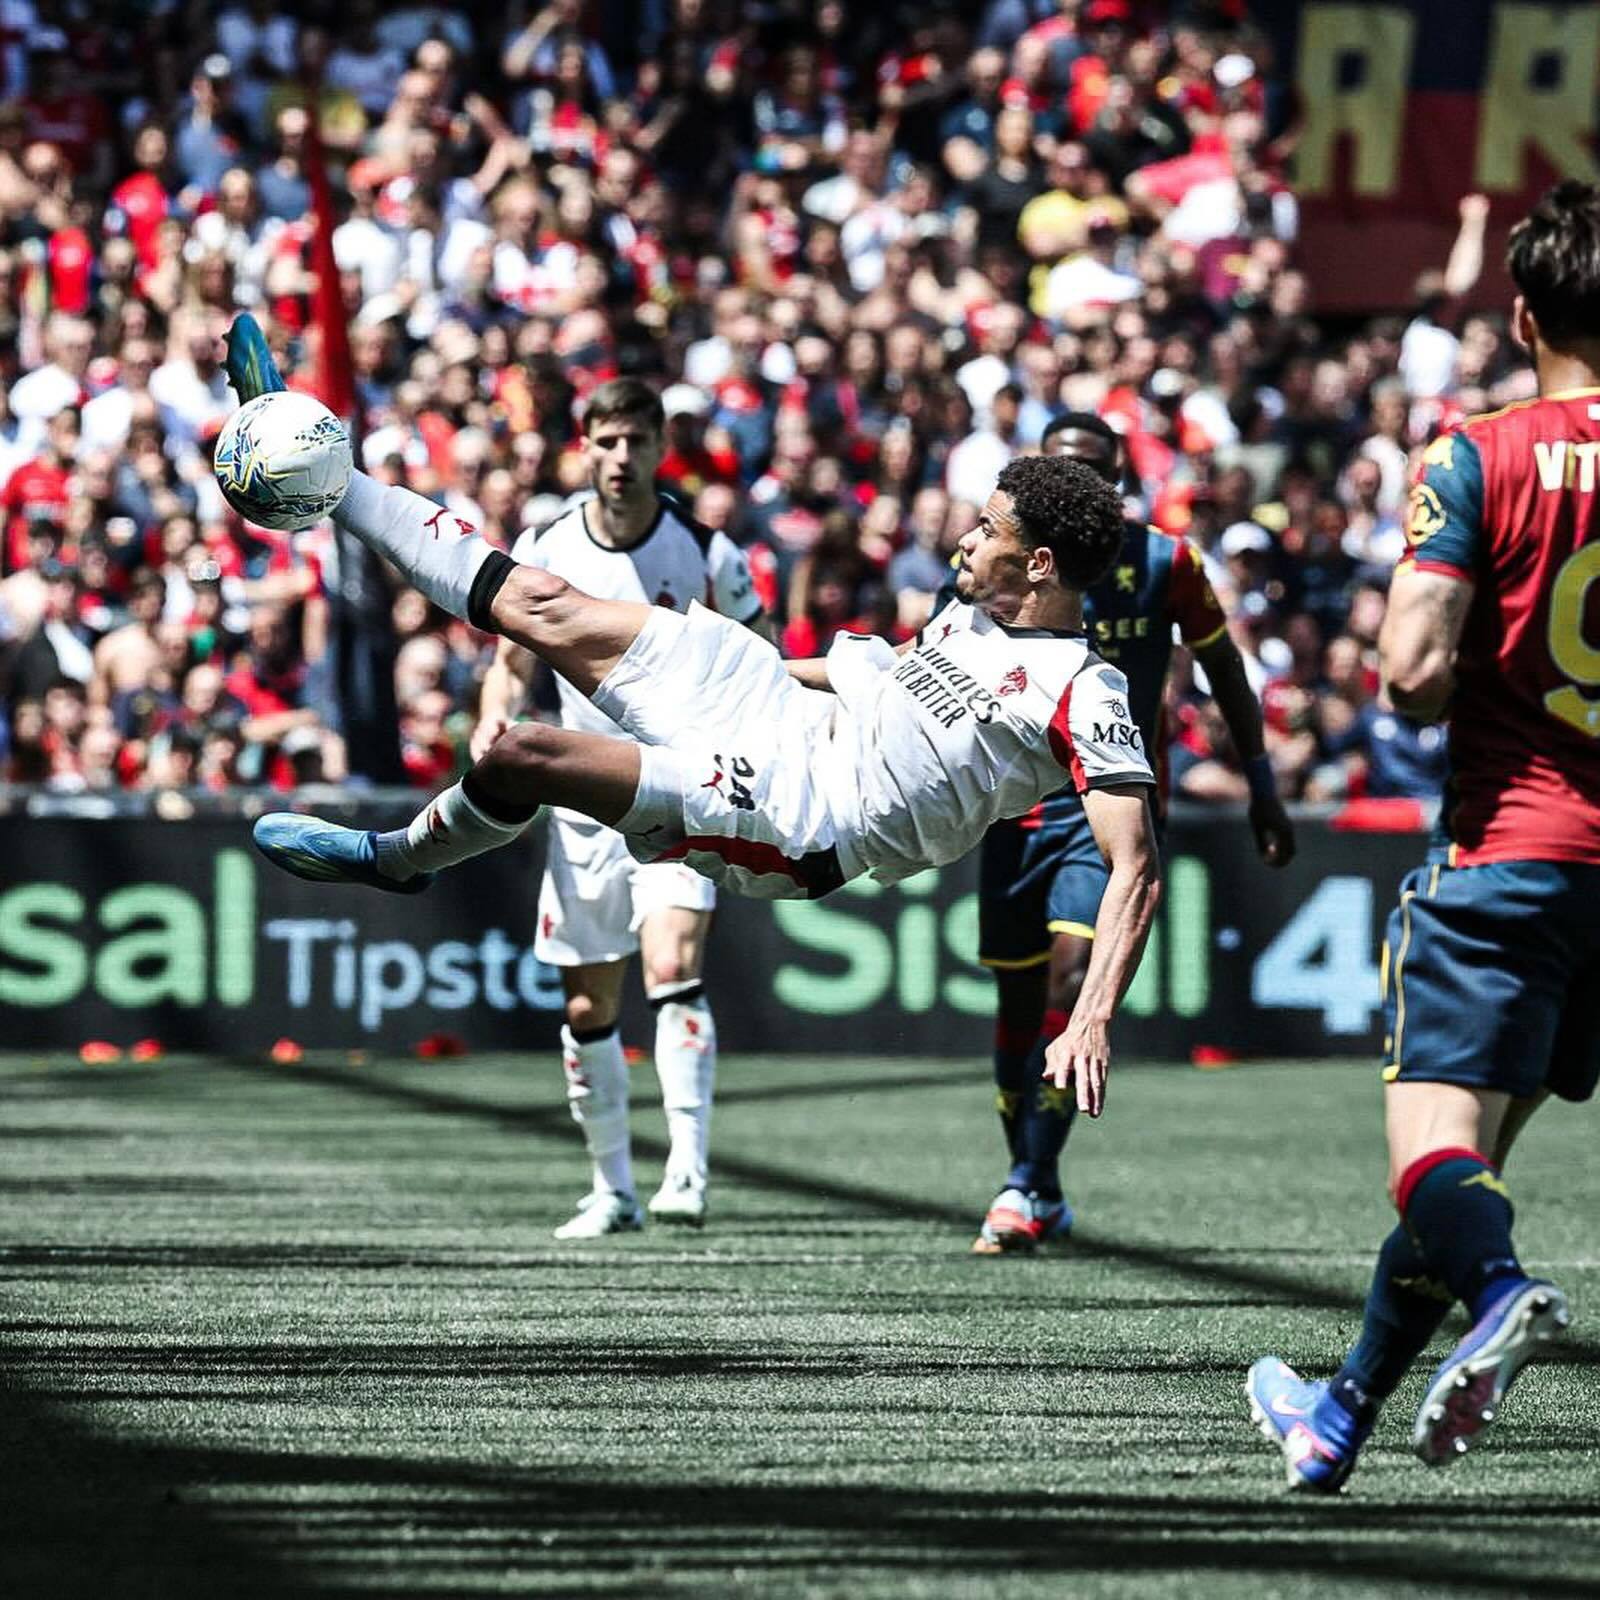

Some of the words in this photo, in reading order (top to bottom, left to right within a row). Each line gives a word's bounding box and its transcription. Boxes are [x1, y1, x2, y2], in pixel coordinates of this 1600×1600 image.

[1533, 440, 1600, 493] VIT
[1095, 617, 1150, 640] SEE
[905, 672, 967, 728] BETTER
[1092, 722, 1140, 750] MSC
[773, 856, 1210, 1017] Sisl
[265, 917, 567, 1032] Tipste
